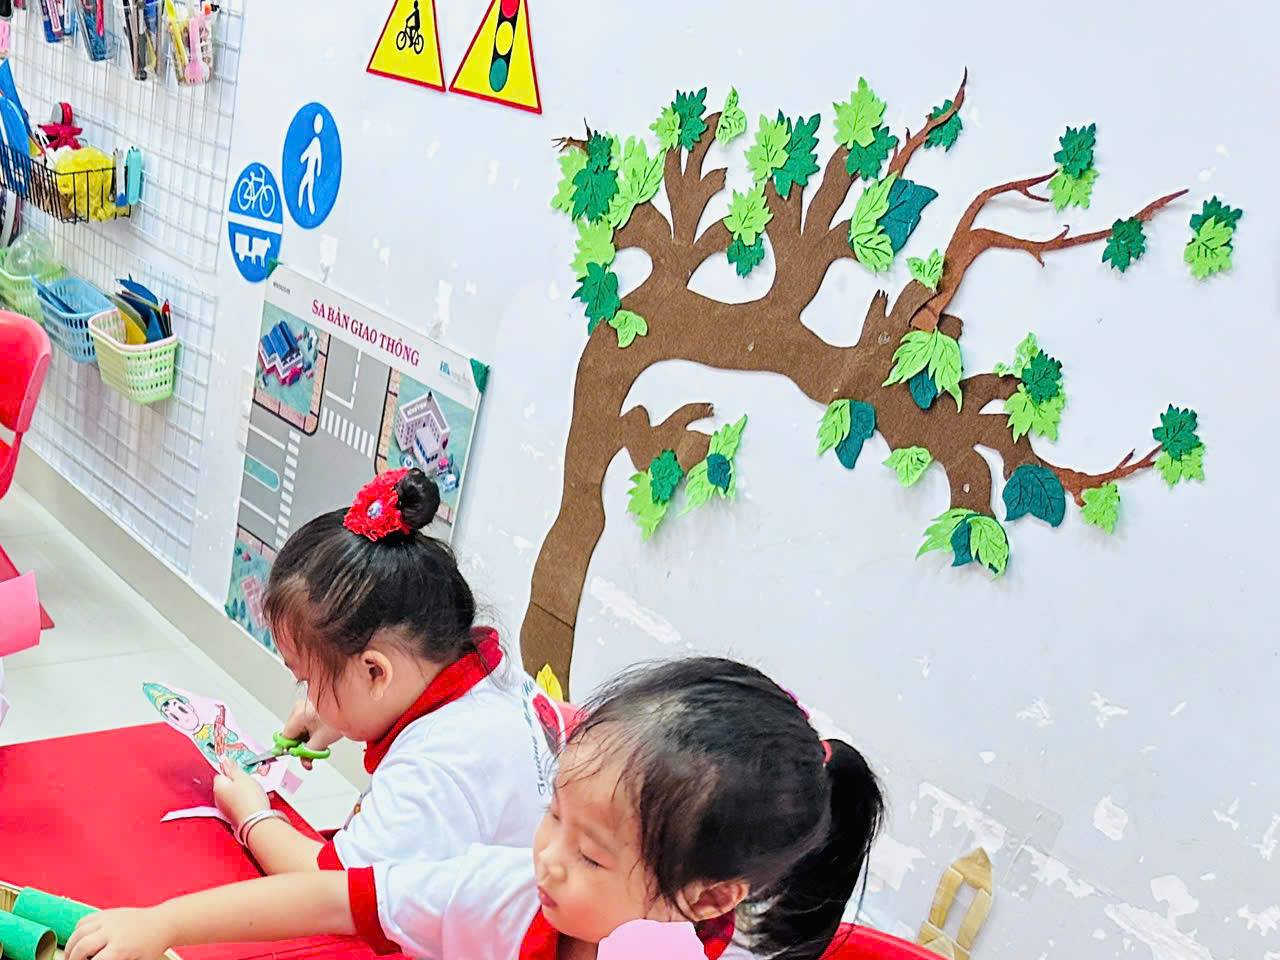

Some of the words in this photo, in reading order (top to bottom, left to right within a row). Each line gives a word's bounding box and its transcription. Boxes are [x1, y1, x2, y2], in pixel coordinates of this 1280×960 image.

[312, 298, 326, 319] SA
[350, 319, 378, 345] GIAO
[379, 332, 420, 367] THÔNG
